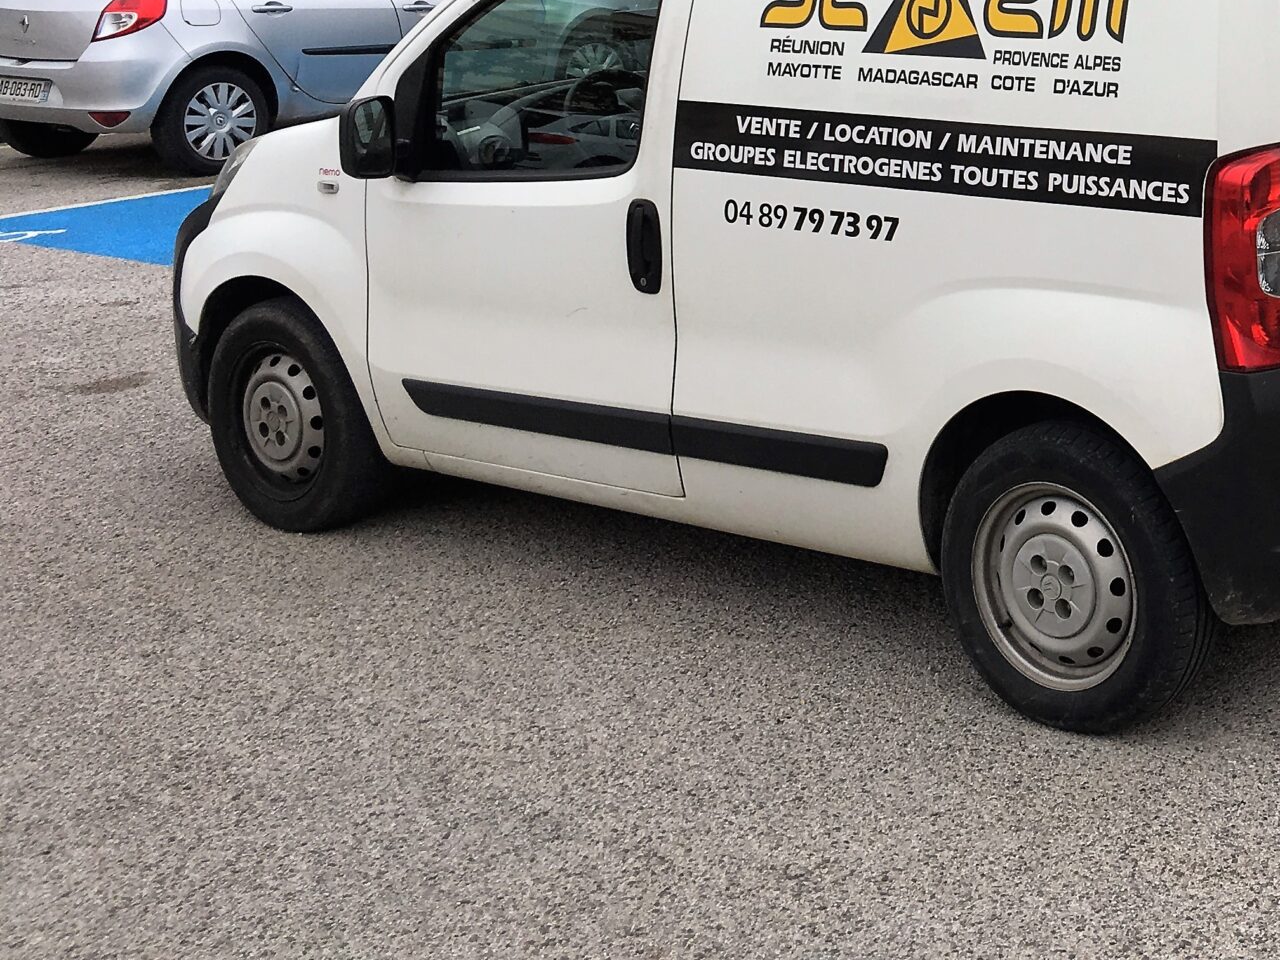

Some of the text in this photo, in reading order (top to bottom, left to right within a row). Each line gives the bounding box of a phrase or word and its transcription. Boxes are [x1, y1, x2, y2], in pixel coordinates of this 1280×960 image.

[770, 36, 845, 56] RÉUNION
[993, 50, 1121, 72] PROVENCE ALPES
[767, 62, 1119, 98] MAYOTTE MADAGASCAR COTE D'AZUR
[736, 115, 802, 138] VENTE
[823, 123, 932, 149] LOCATION
[957, 133, 1133, 165] MAINTENANCE
[319, 167, 341, 176] nemo
[690, 141, 1190, 204] GROUPES ELECTROGENES TOUTES PUISSANCES
[724, 198, 900, 241] 04 89 79 73 97
